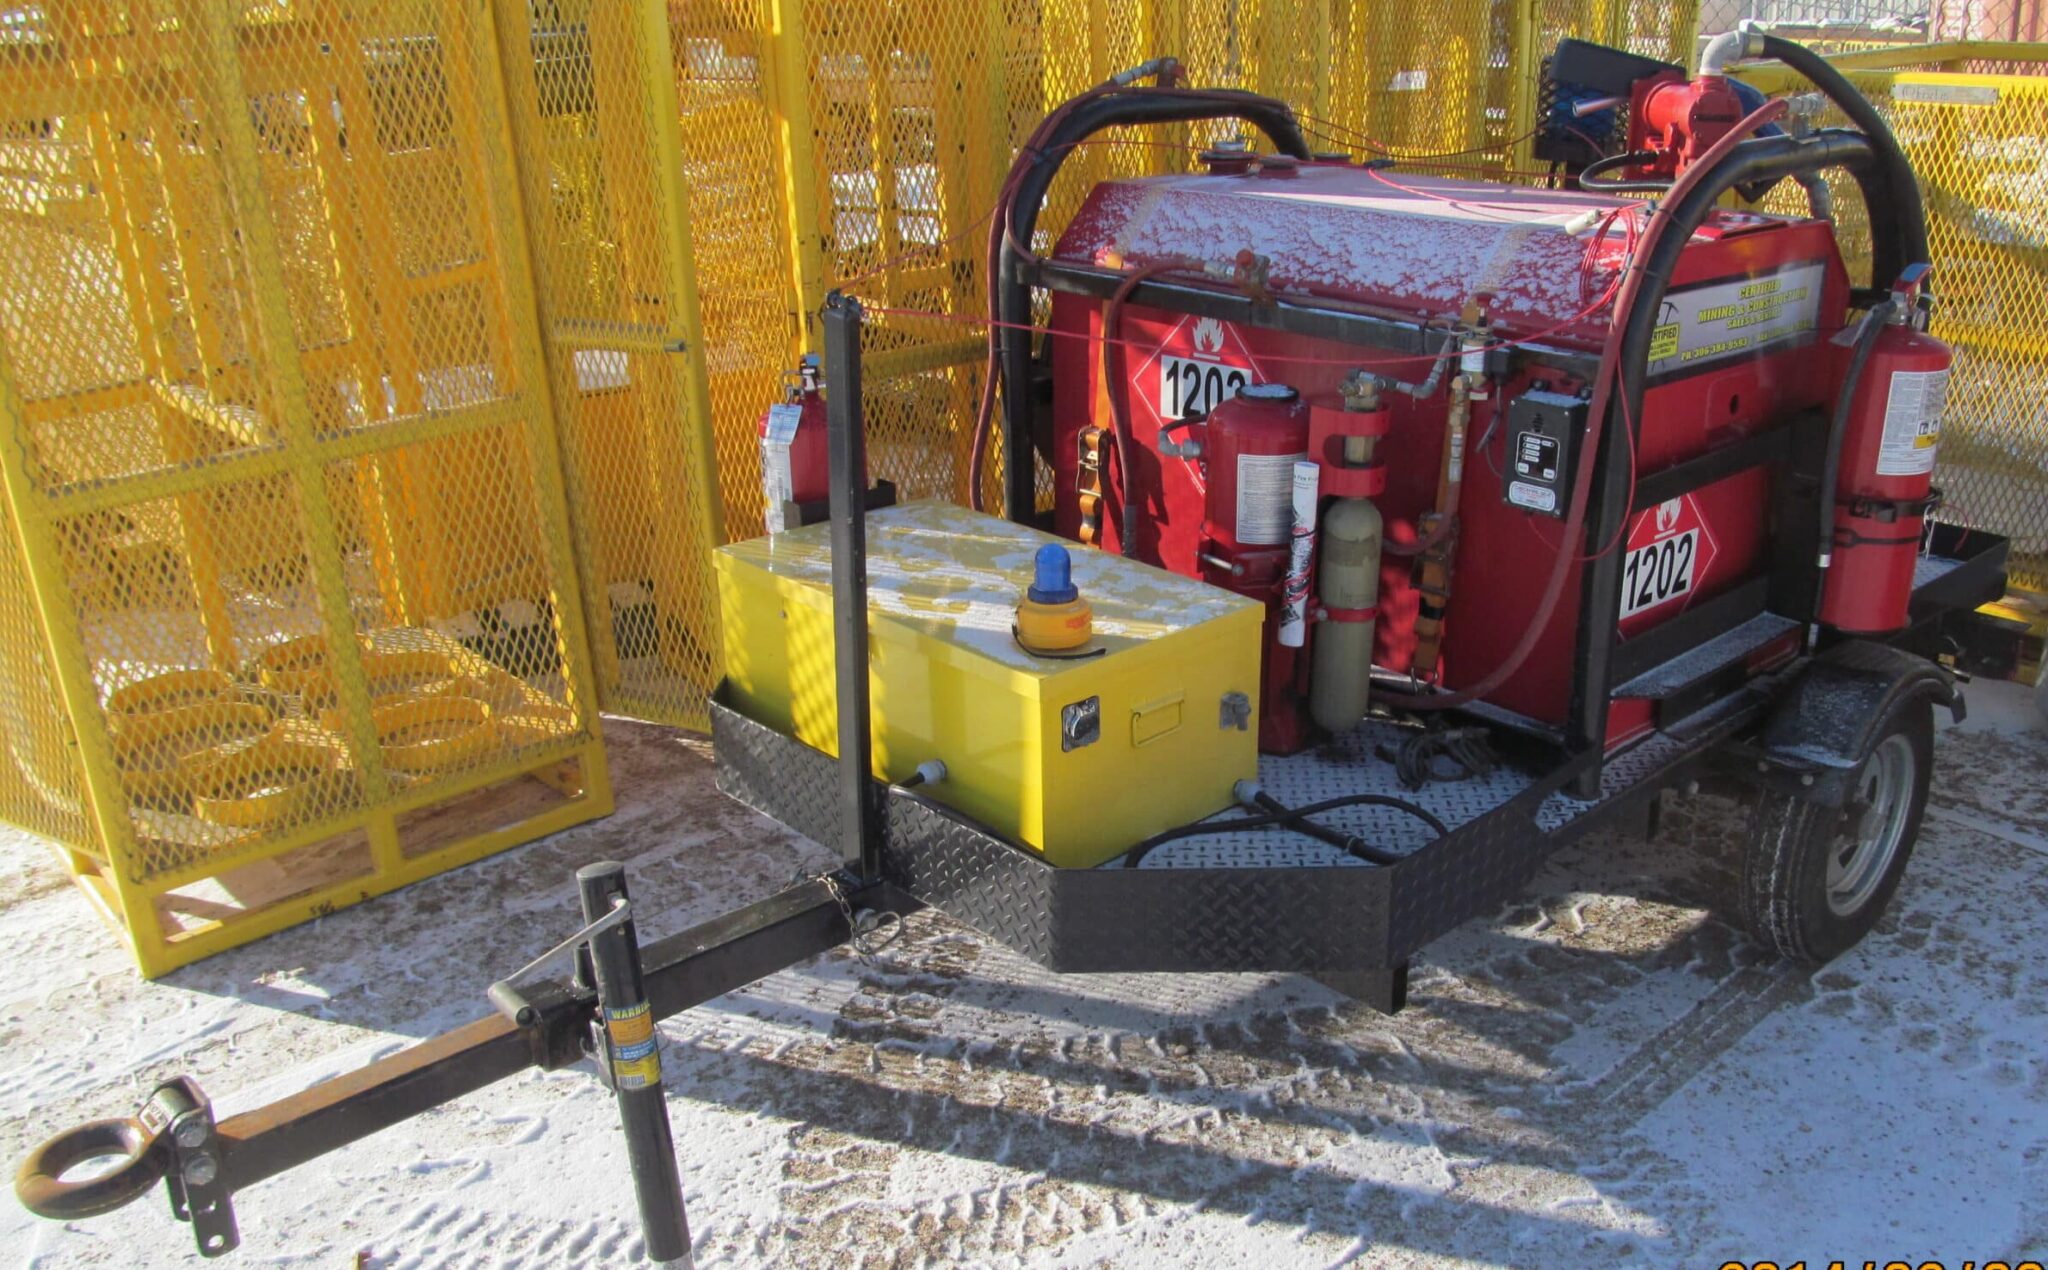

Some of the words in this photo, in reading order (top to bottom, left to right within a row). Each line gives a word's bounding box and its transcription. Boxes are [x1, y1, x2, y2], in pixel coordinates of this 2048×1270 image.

[1739, 280, 1780, 298] CERTIFIED
[1699, 304, 1736, 323] MINING
[1749, 287, 1807, 312] CONSTRUCTION
[1727, 317, 1750, 329] SALES
[1653, 327, 1677, 341] RTIFIED
[1626, 533, 1693, 611] 1202
